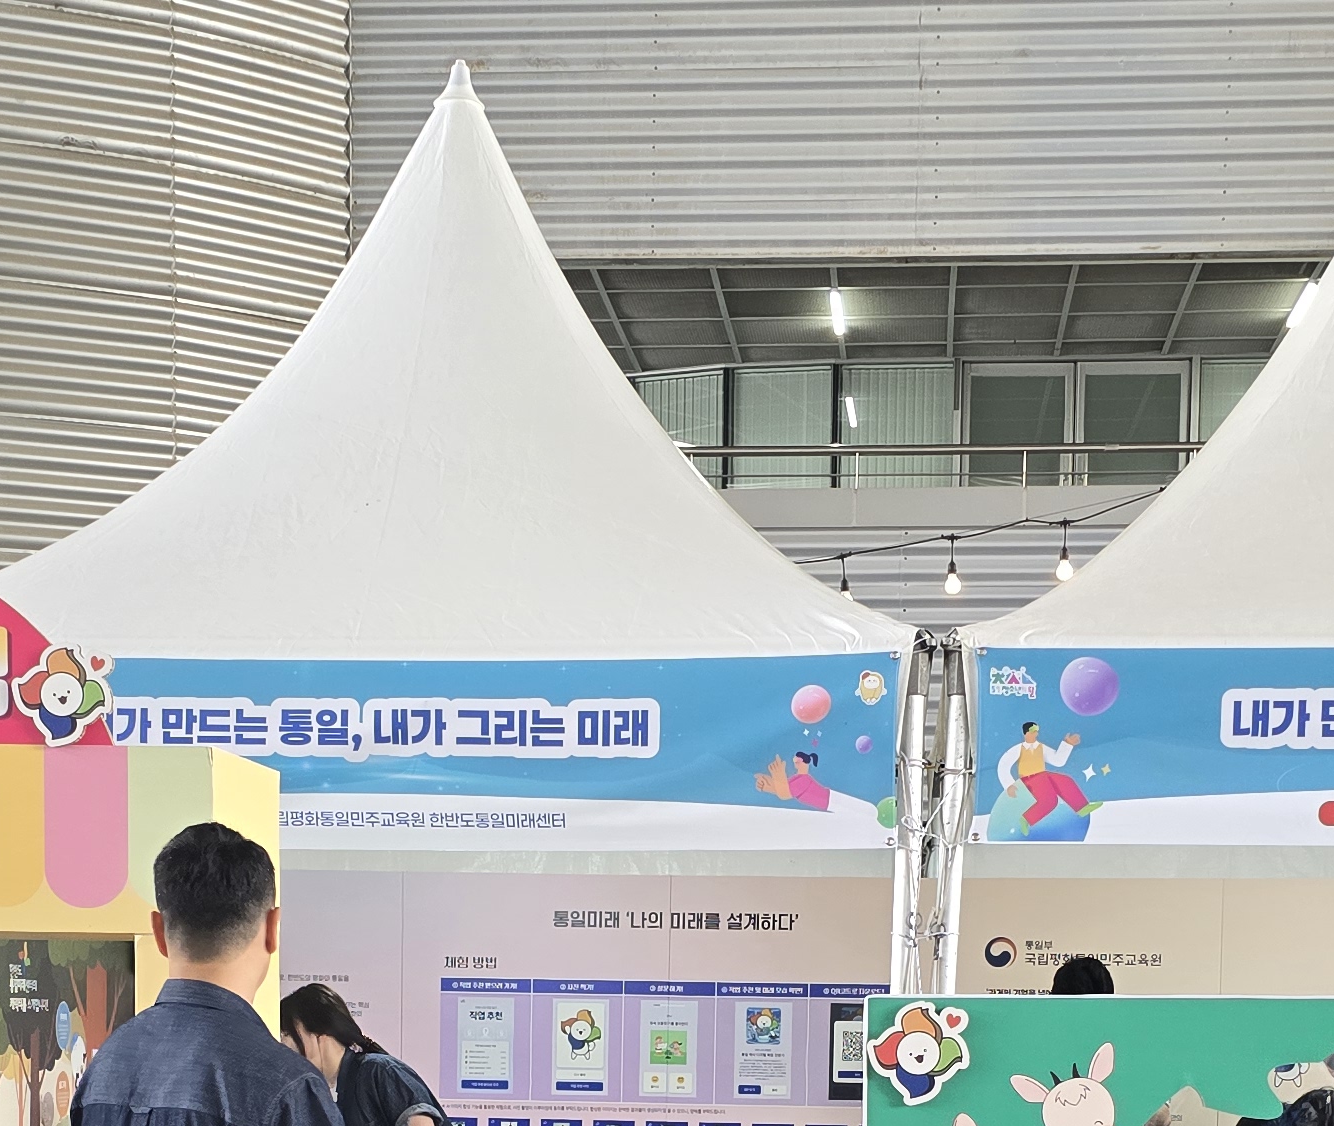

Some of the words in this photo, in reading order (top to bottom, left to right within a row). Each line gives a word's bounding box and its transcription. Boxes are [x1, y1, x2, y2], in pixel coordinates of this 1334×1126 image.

[1232, 699, 1311, 739] 내가
[106, 708, 152, 744] 가
[161, 708, 268, 745] 만드는
[278, 708, 363, 751] 통일,
[373, 709, 447, 746] 내가
[455, 709, 565, 747] 그리는
[577, 709, 650, 748] 미래
[429, 812, 566, 830] 한반도통일미래센터
[553, 910, 621, 928] 통일미래
[670, 912, 721, 930] 미래를
[1025, 940, 1053, 950] 통일부
[444, 956, 469, 969] 체험
[472, 956, 497, 969] 방법
[1024, 952, 1163, 967] 국립평화민주교육원
[469, 1011, 485, 1021] 직업
[487, 1011, 503, 1021] 추천
